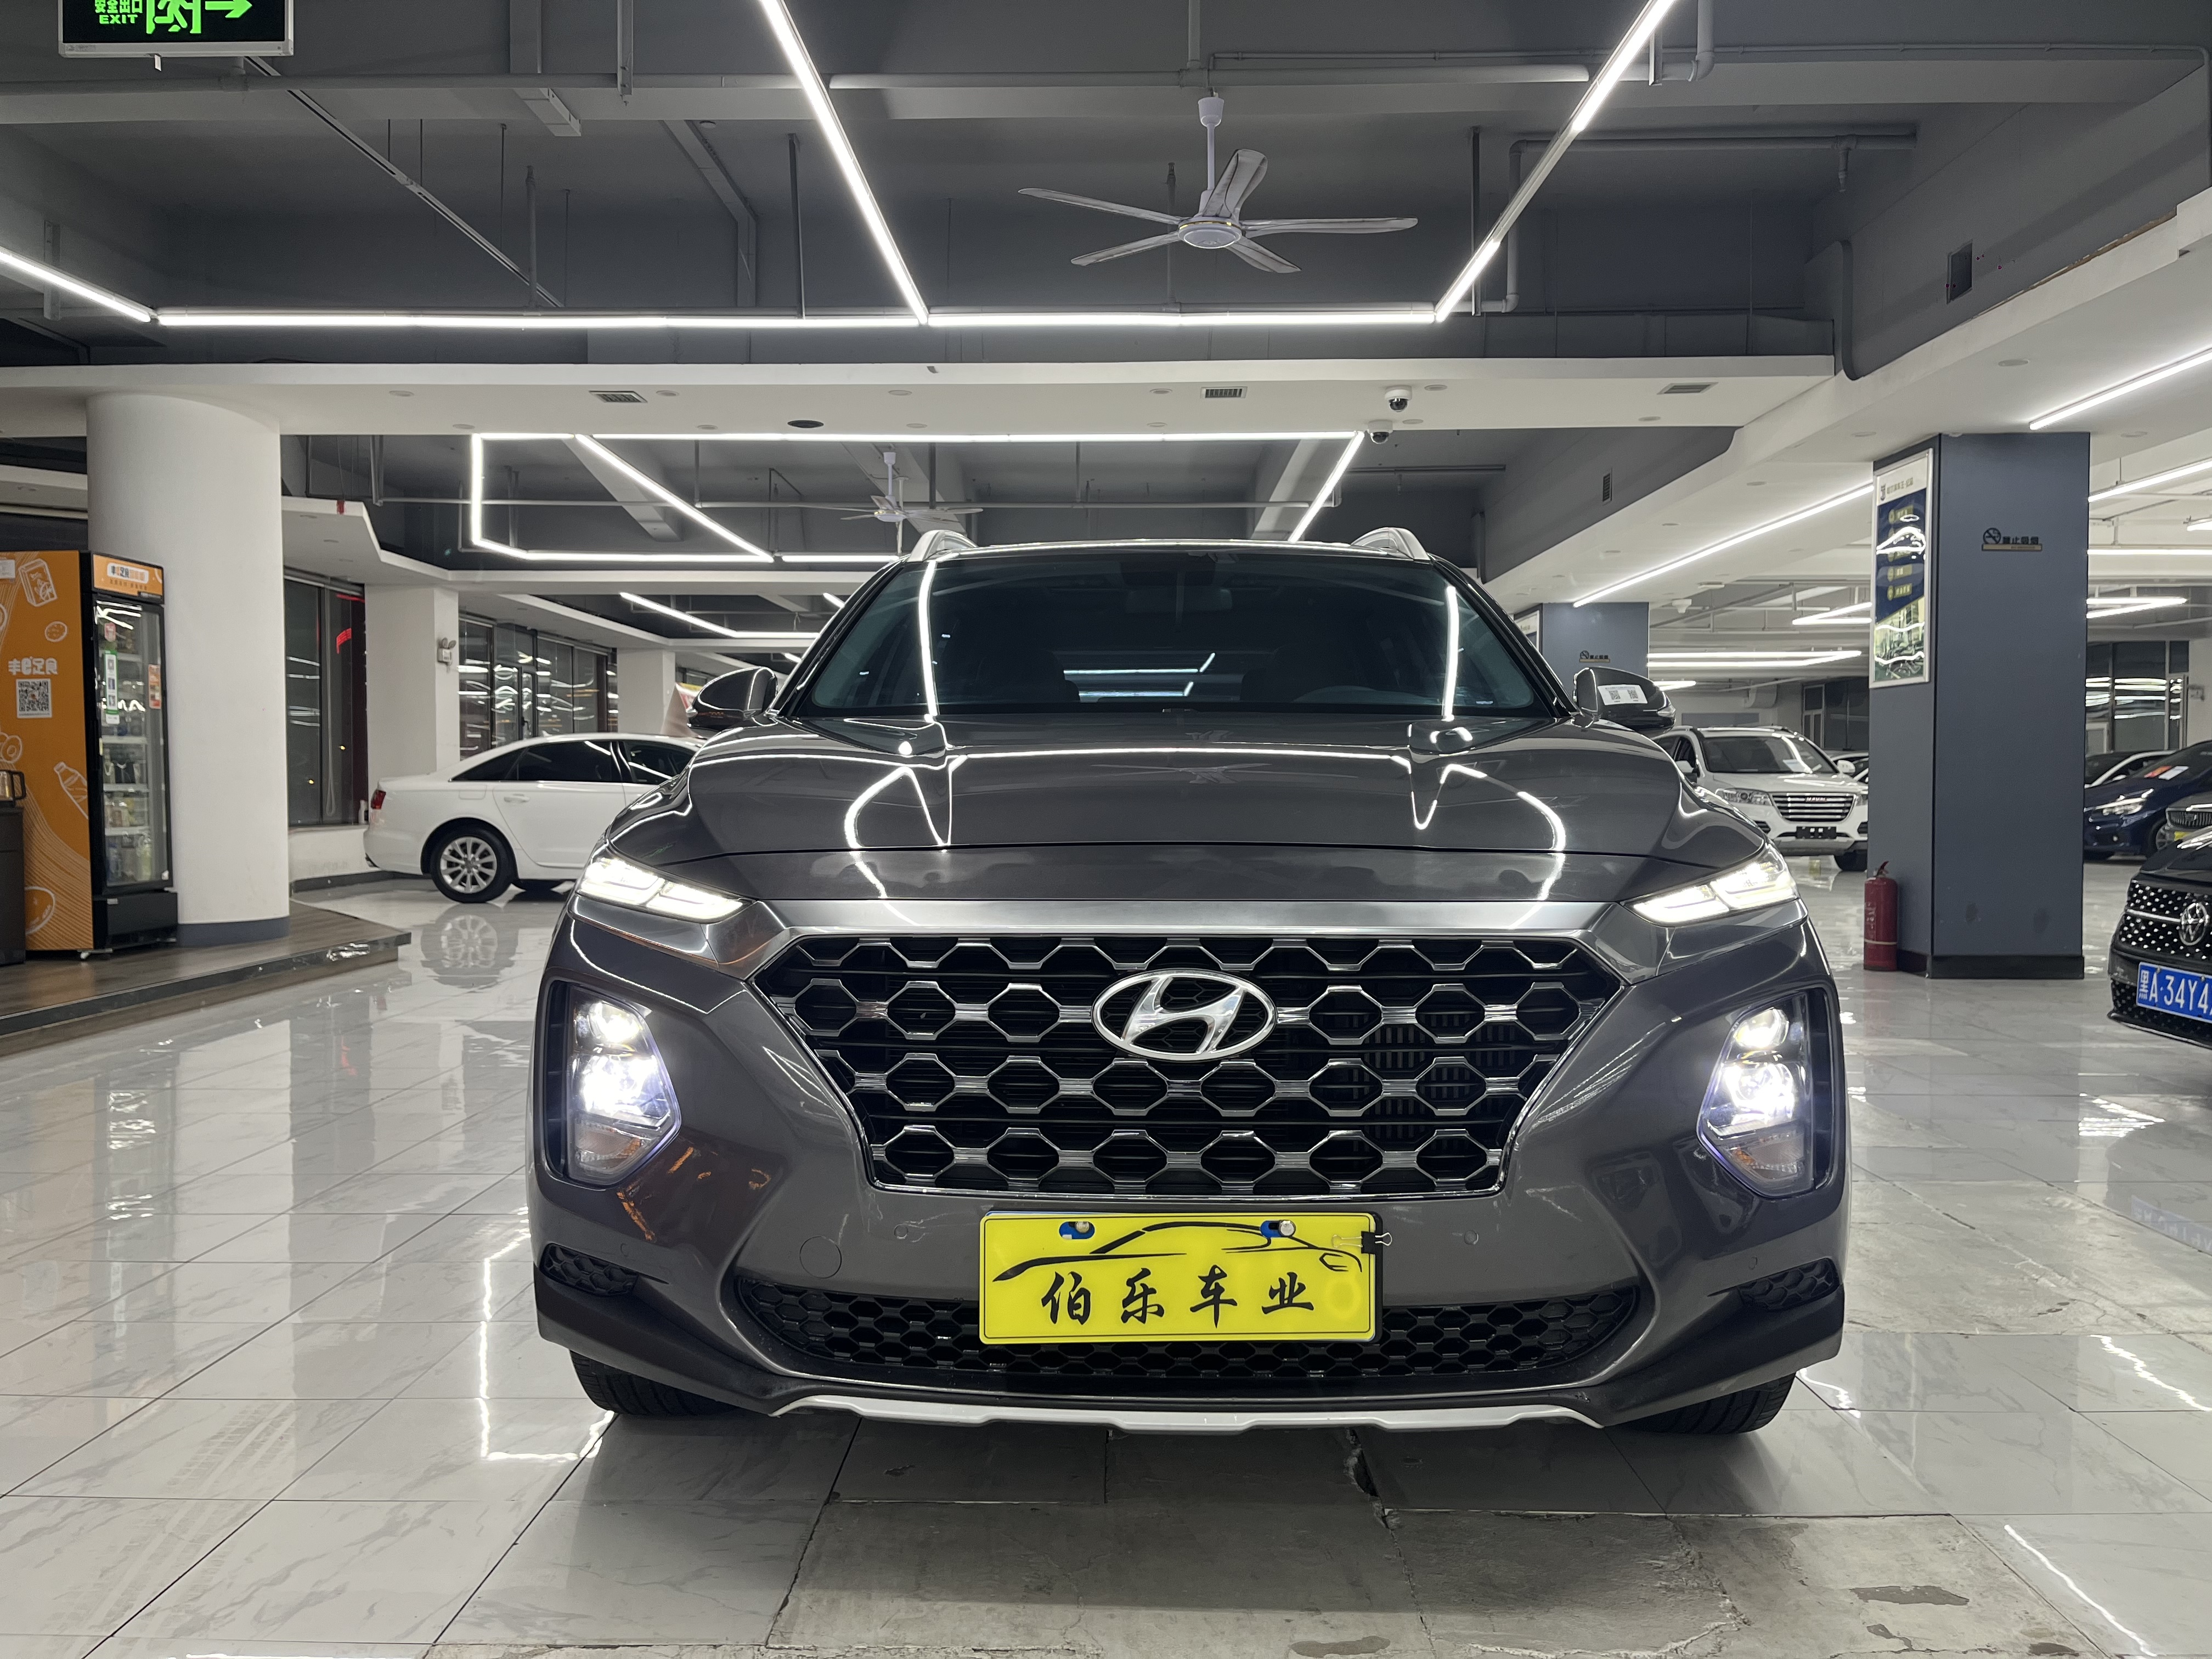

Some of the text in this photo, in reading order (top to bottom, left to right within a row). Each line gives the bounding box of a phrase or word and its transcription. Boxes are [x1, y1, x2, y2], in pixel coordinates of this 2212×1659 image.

[99, 14, 138, 24] EXIT
[2139, 970, 2212, 1015] 黑A·34Y4
[1040, 1263, 1314, 1328] 伯乐车业
